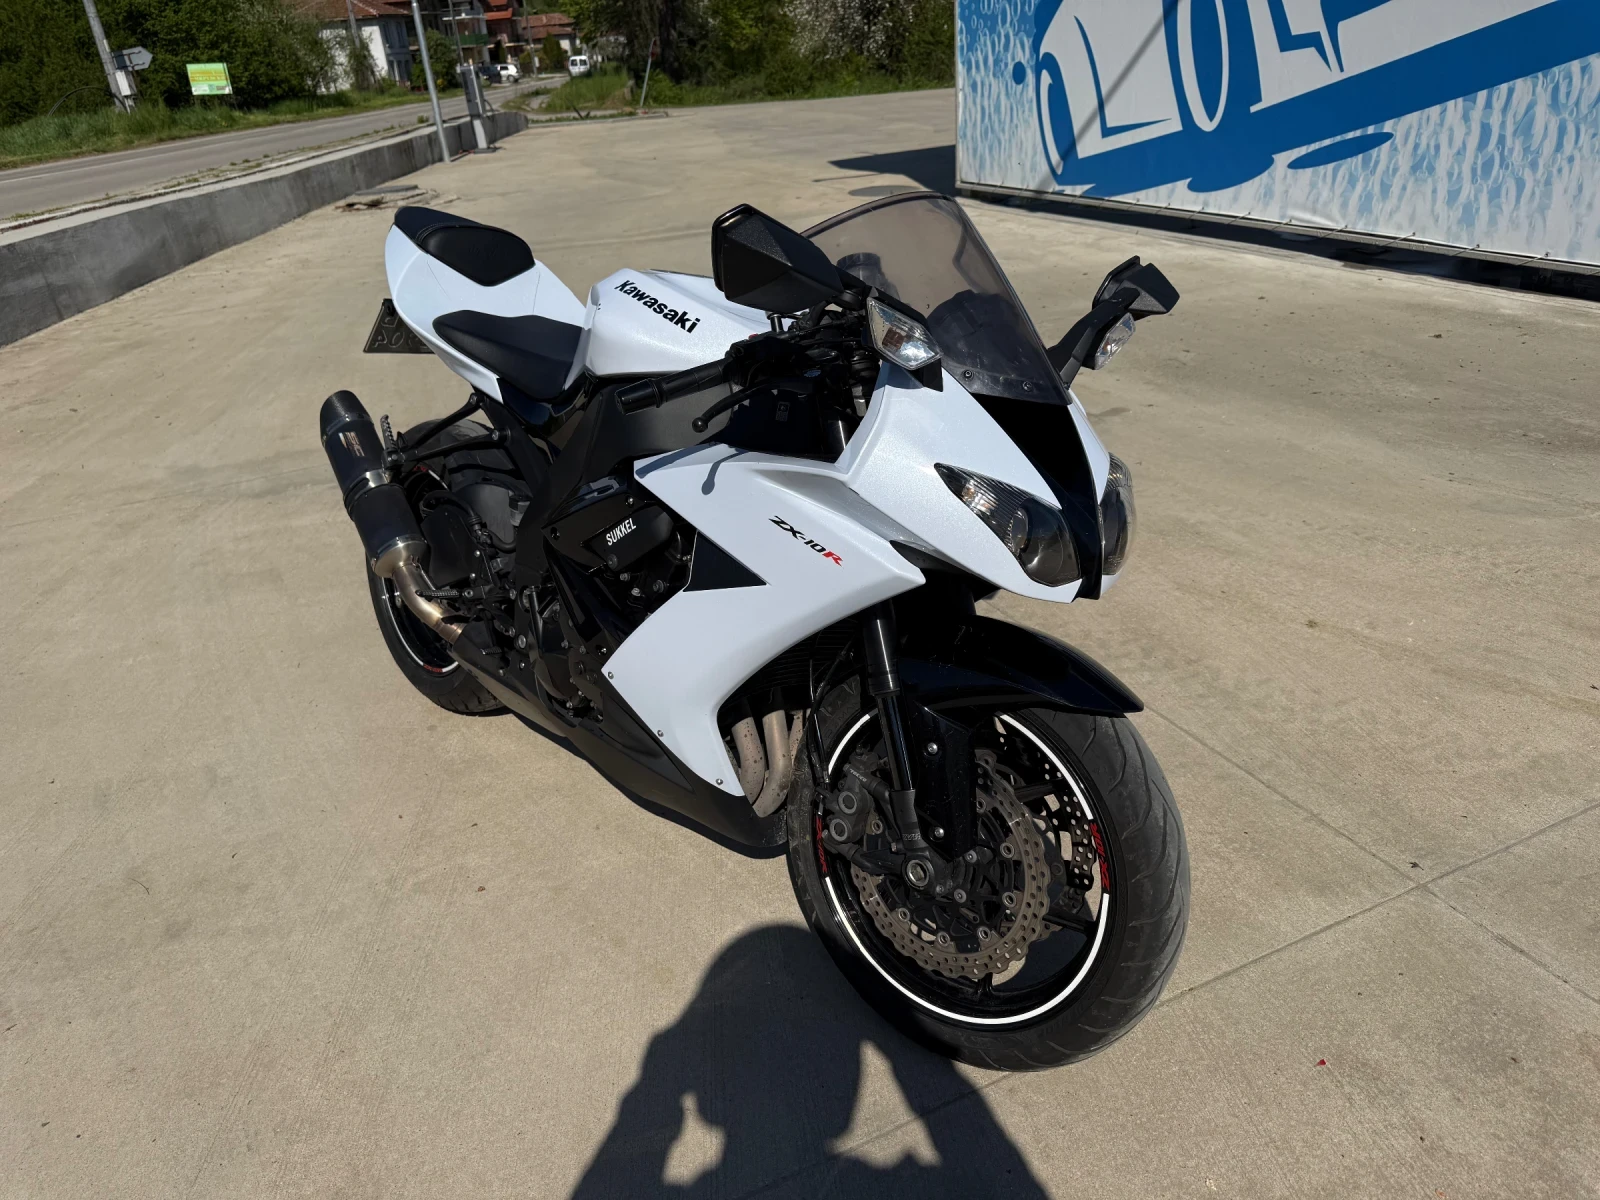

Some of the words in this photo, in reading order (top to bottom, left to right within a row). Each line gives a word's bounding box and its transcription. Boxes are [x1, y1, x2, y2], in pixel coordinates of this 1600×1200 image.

[614, 280, 700, 333] Kawasaki
[606, 518, 636, 546] SUKKEL
[768, 515, 843, 567] ZX-10R
